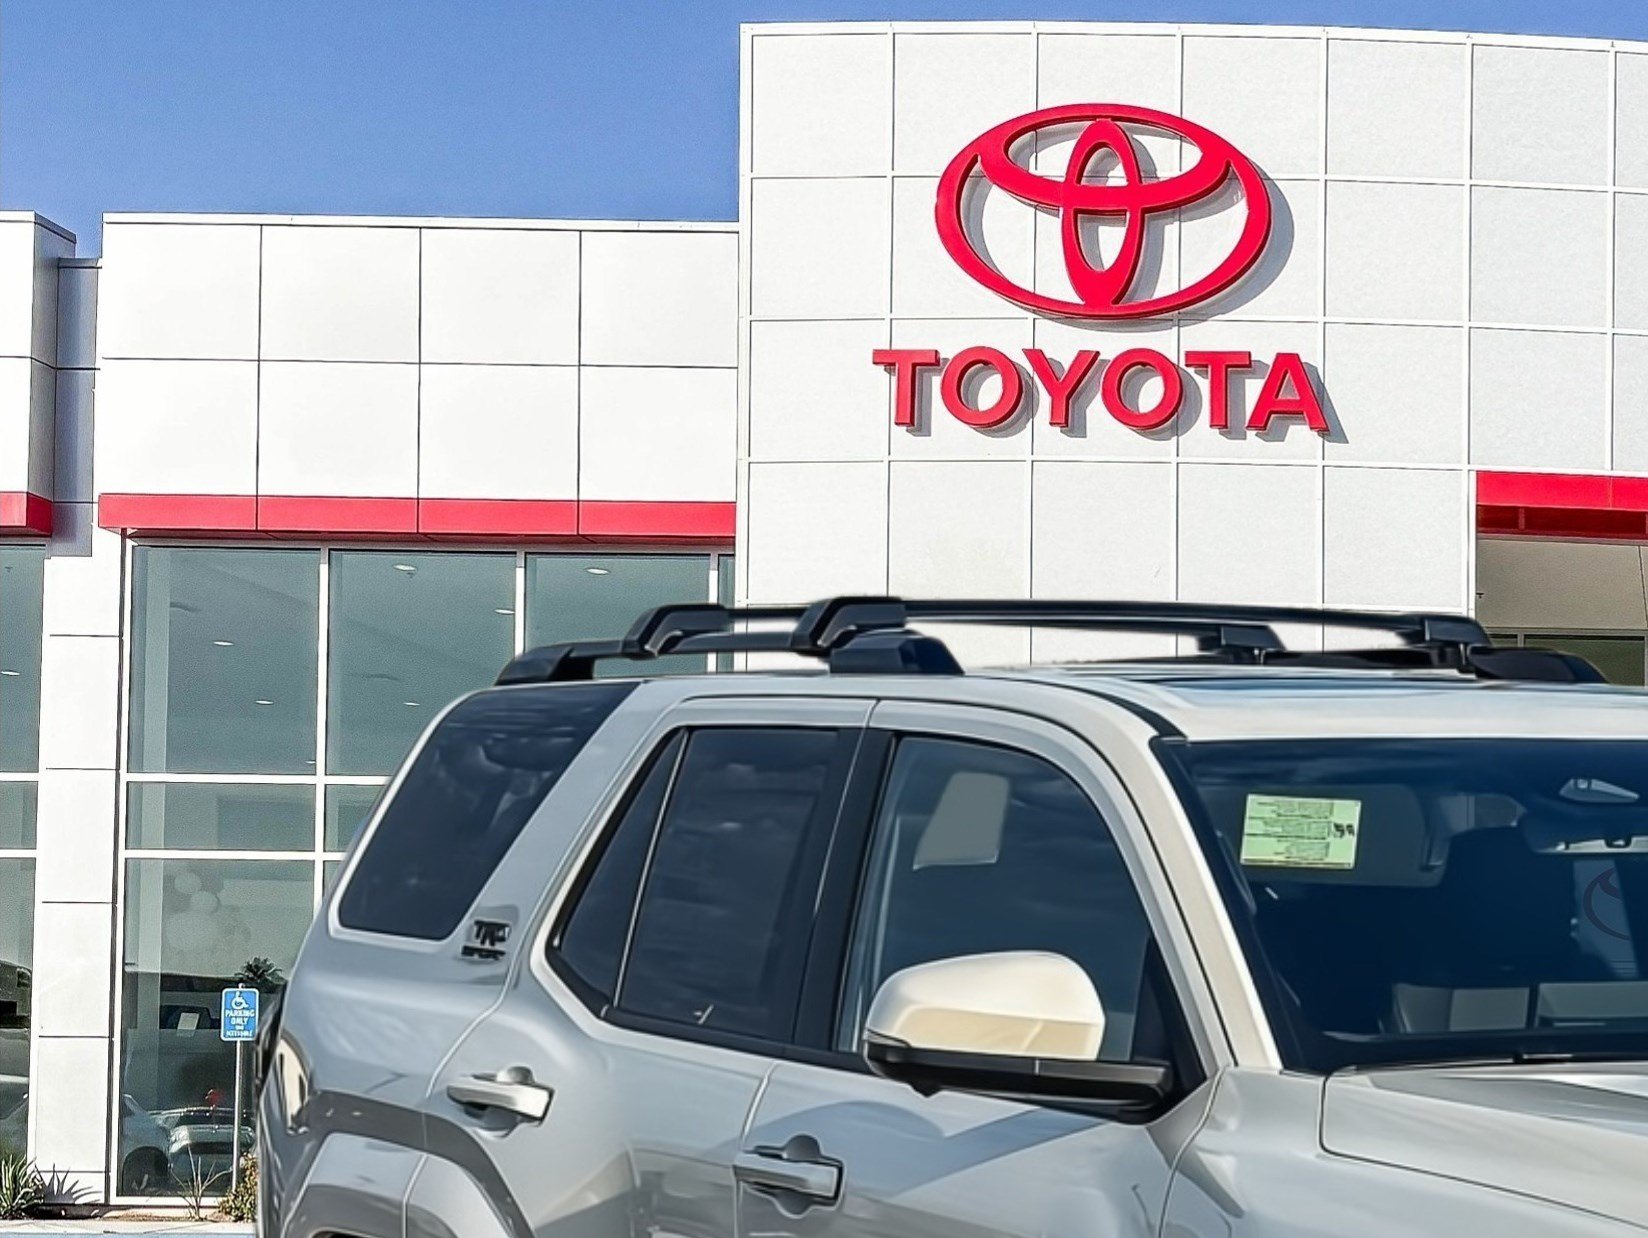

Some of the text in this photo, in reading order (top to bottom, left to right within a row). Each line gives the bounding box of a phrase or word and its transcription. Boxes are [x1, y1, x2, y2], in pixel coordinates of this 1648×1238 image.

[872, 346, 1330, 432] TOYOTA
[225, 1009, 255, 1017] PARKING
[231, 1017, 248, 1025] ONLY
